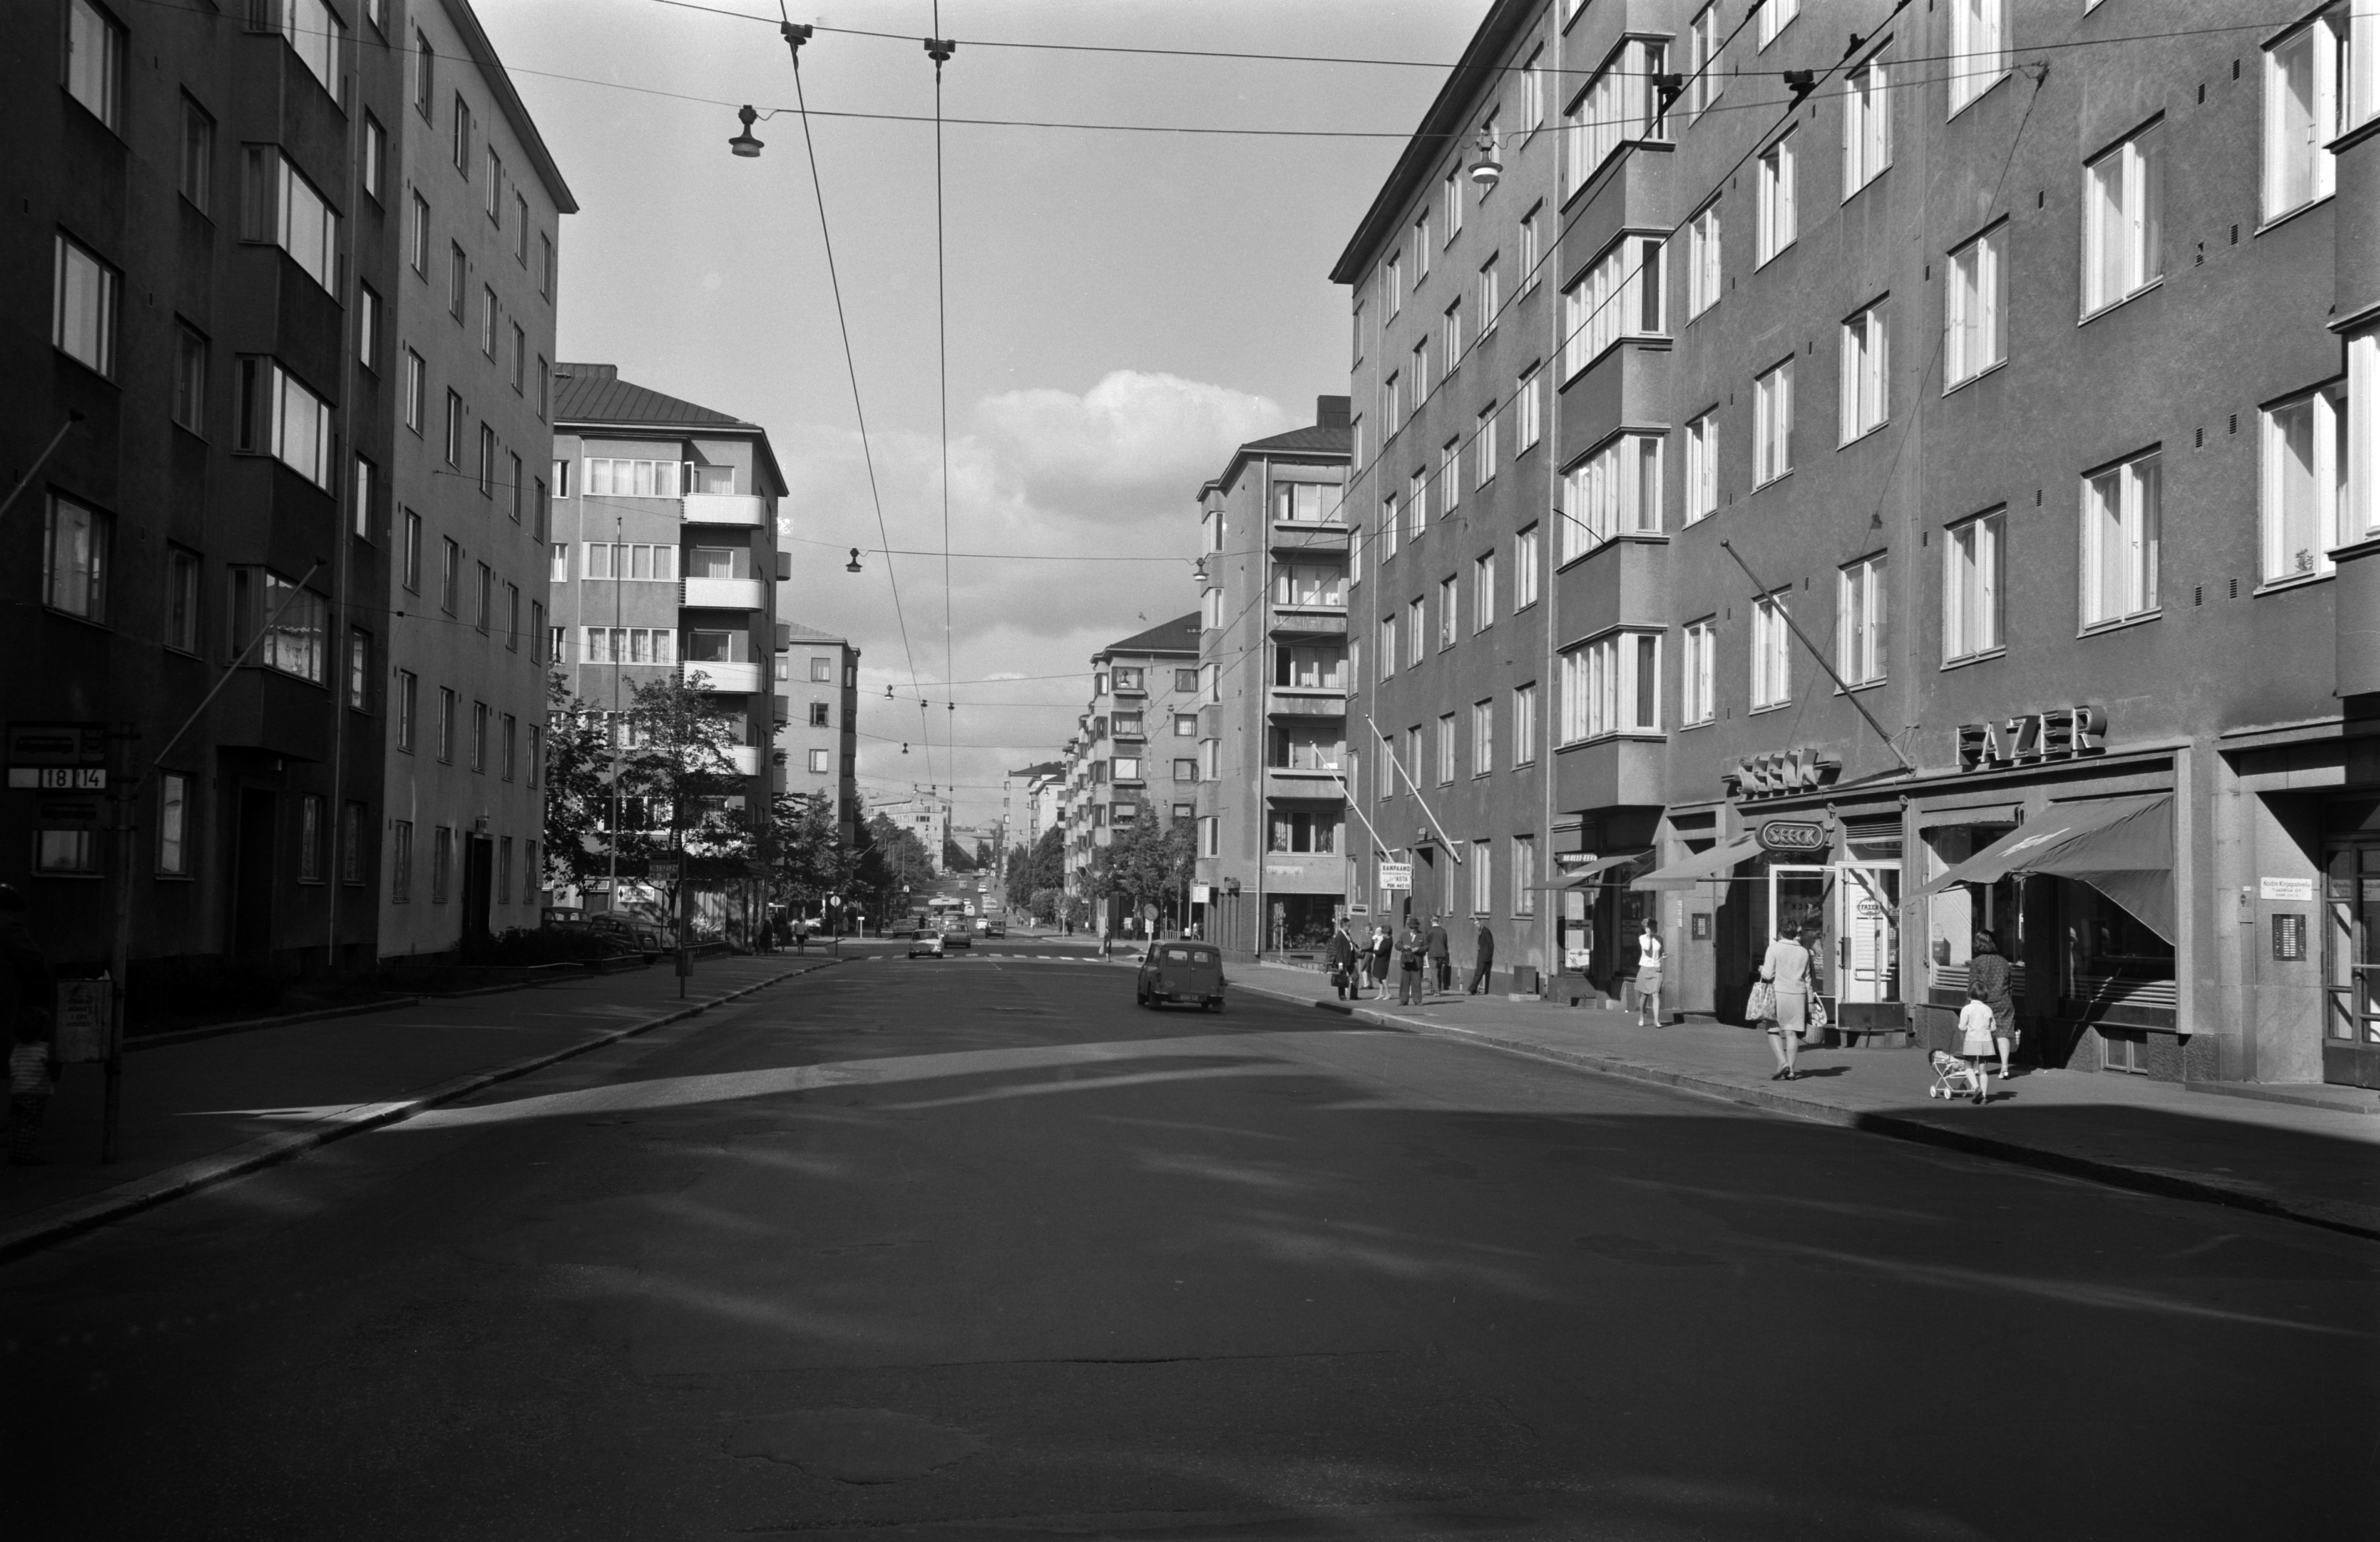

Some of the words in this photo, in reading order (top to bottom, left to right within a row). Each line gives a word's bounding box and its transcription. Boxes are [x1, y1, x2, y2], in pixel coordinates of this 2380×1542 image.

[1956, 705, 2107, 766] FAZER
[48, 769, 66, 787] 18
[84, 769, 99, 787] 14
[1768, 828, 1817, 845] SEECK
[2279, 881, 2311, 889] Kirjapalvelu
